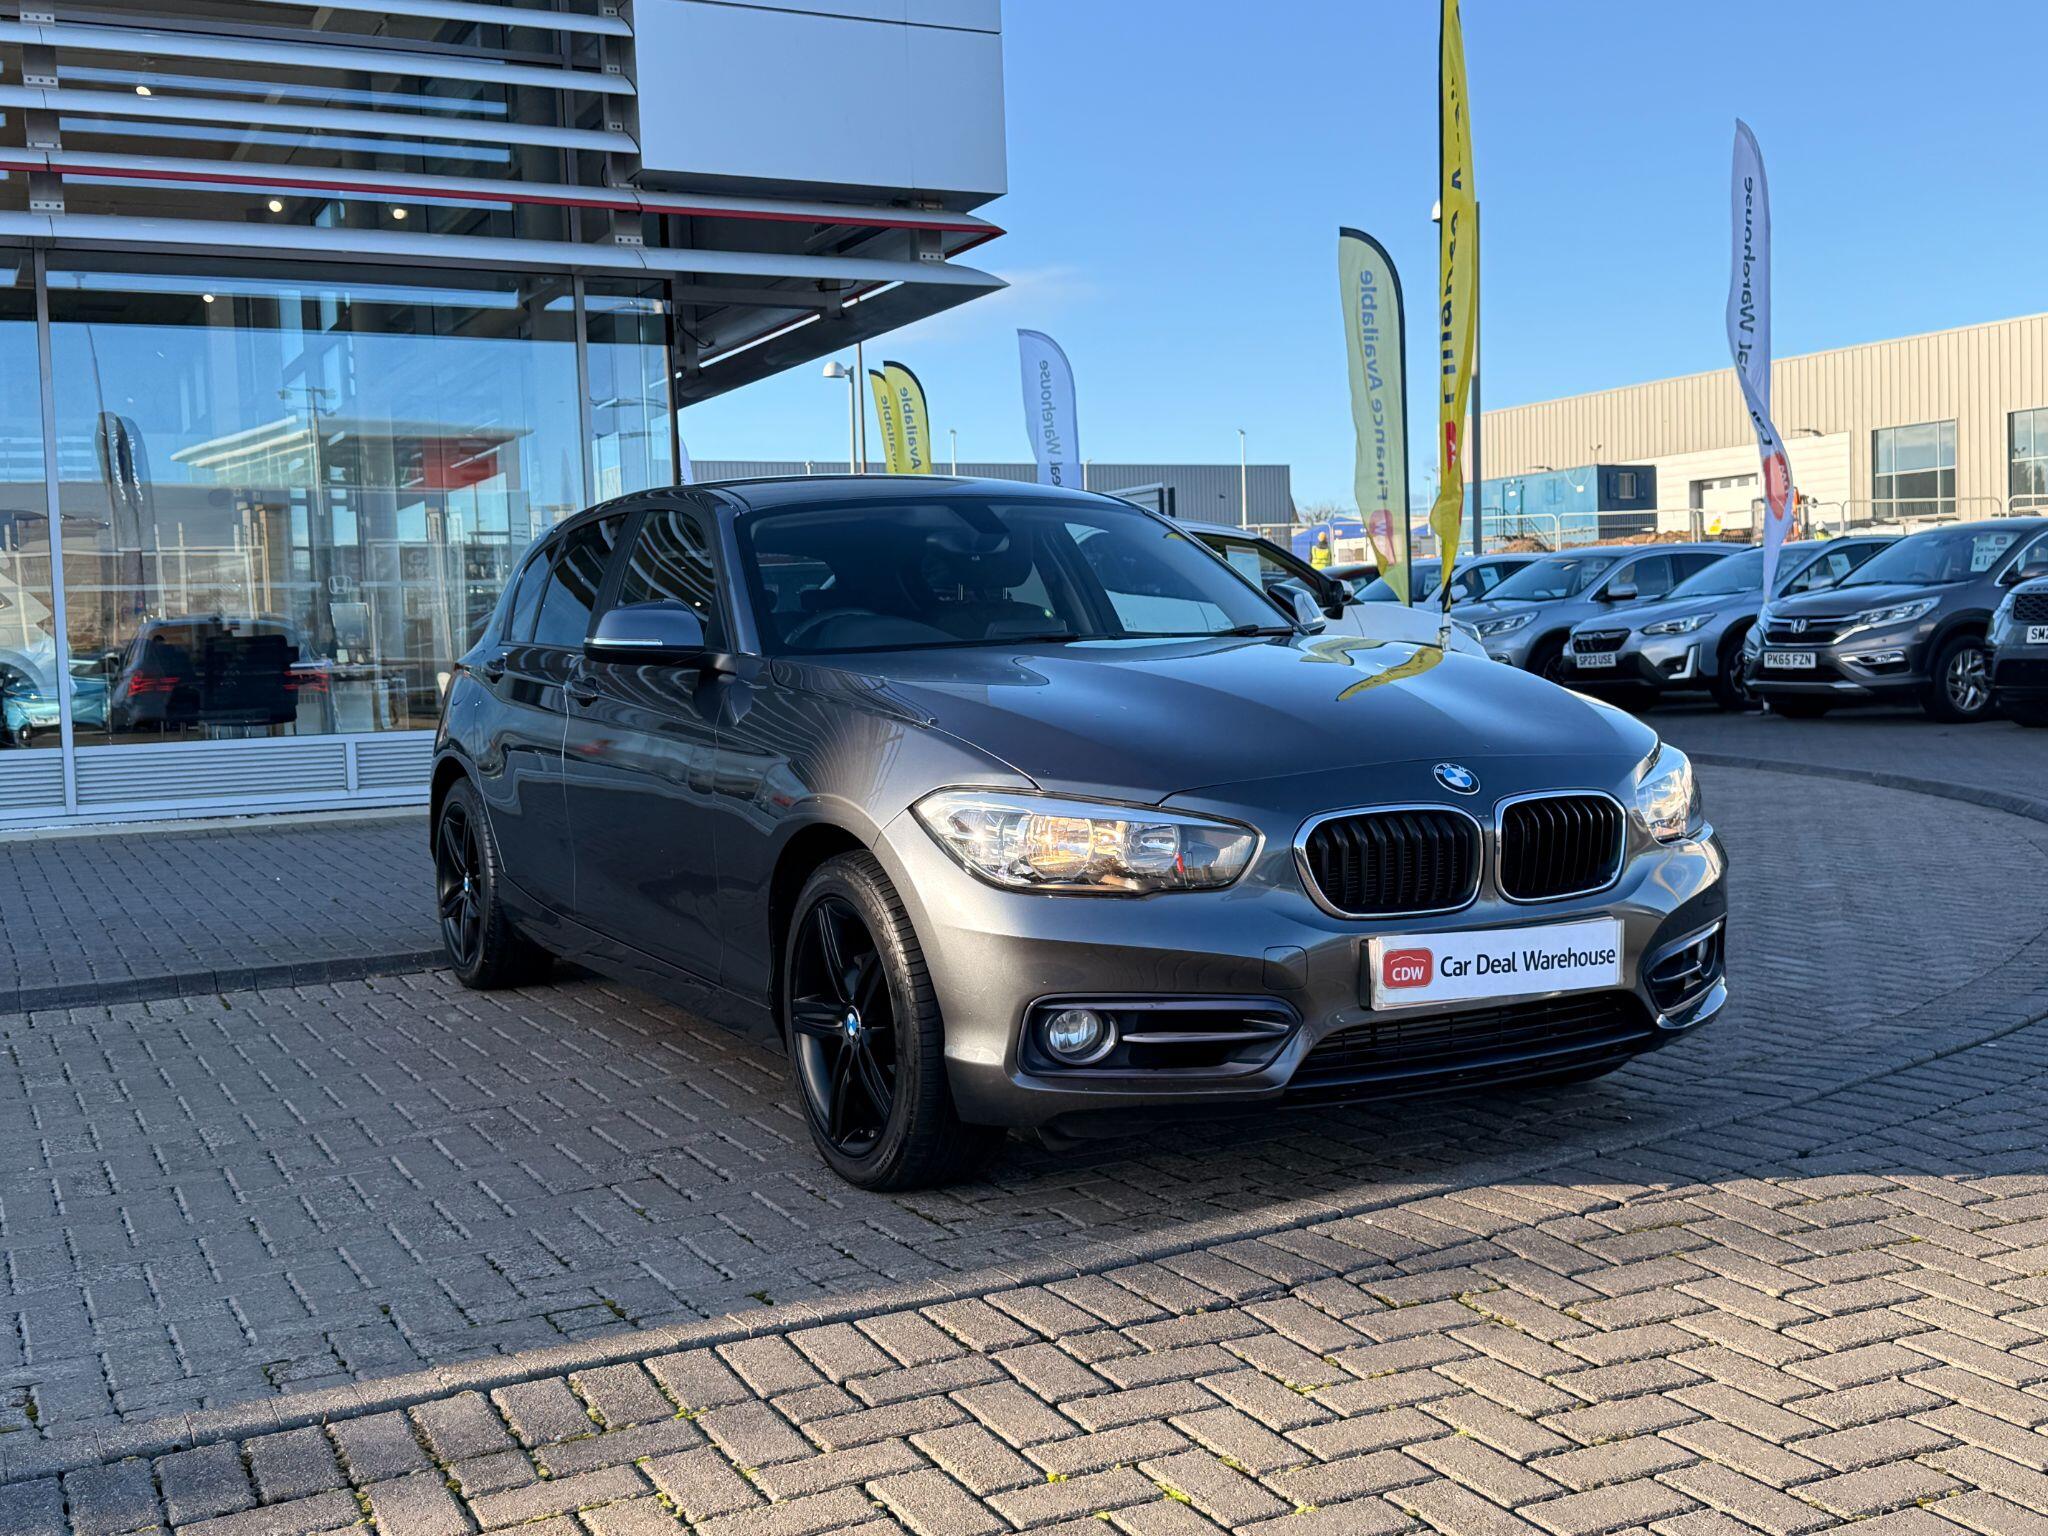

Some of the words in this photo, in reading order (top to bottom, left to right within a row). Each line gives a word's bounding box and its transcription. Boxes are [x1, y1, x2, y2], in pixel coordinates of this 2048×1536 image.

[1579, 654, 1597, 666] SP23
[1598, 653, 1613, 665] USE
[1767, 654, 1791, 665] PK65
[1792, 654, 1811, 665] FZN
[1440, 955, 1472, 978] Car
[1476, 951, 1518, 975] Deal
[1523, 946, 1617, 973] Warehouse
[1391, 965, 1424, 981] CDW
